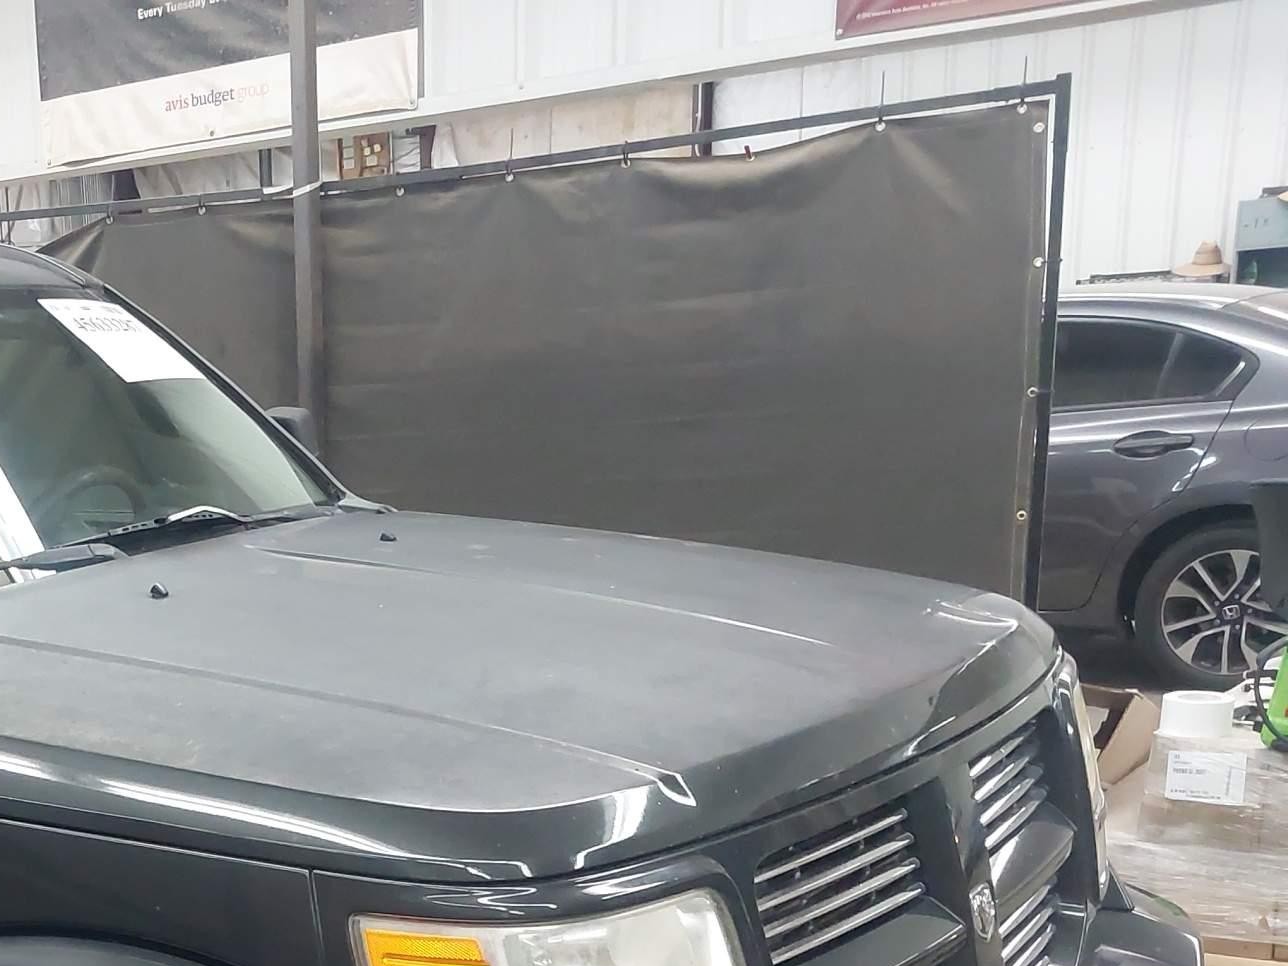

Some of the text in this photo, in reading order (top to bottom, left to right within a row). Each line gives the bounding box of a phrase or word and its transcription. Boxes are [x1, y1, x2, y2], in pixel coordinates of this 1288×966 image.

[137, 0, 207, 20] Every Tuesday
[165, 82, 270, 112] avis budget group
